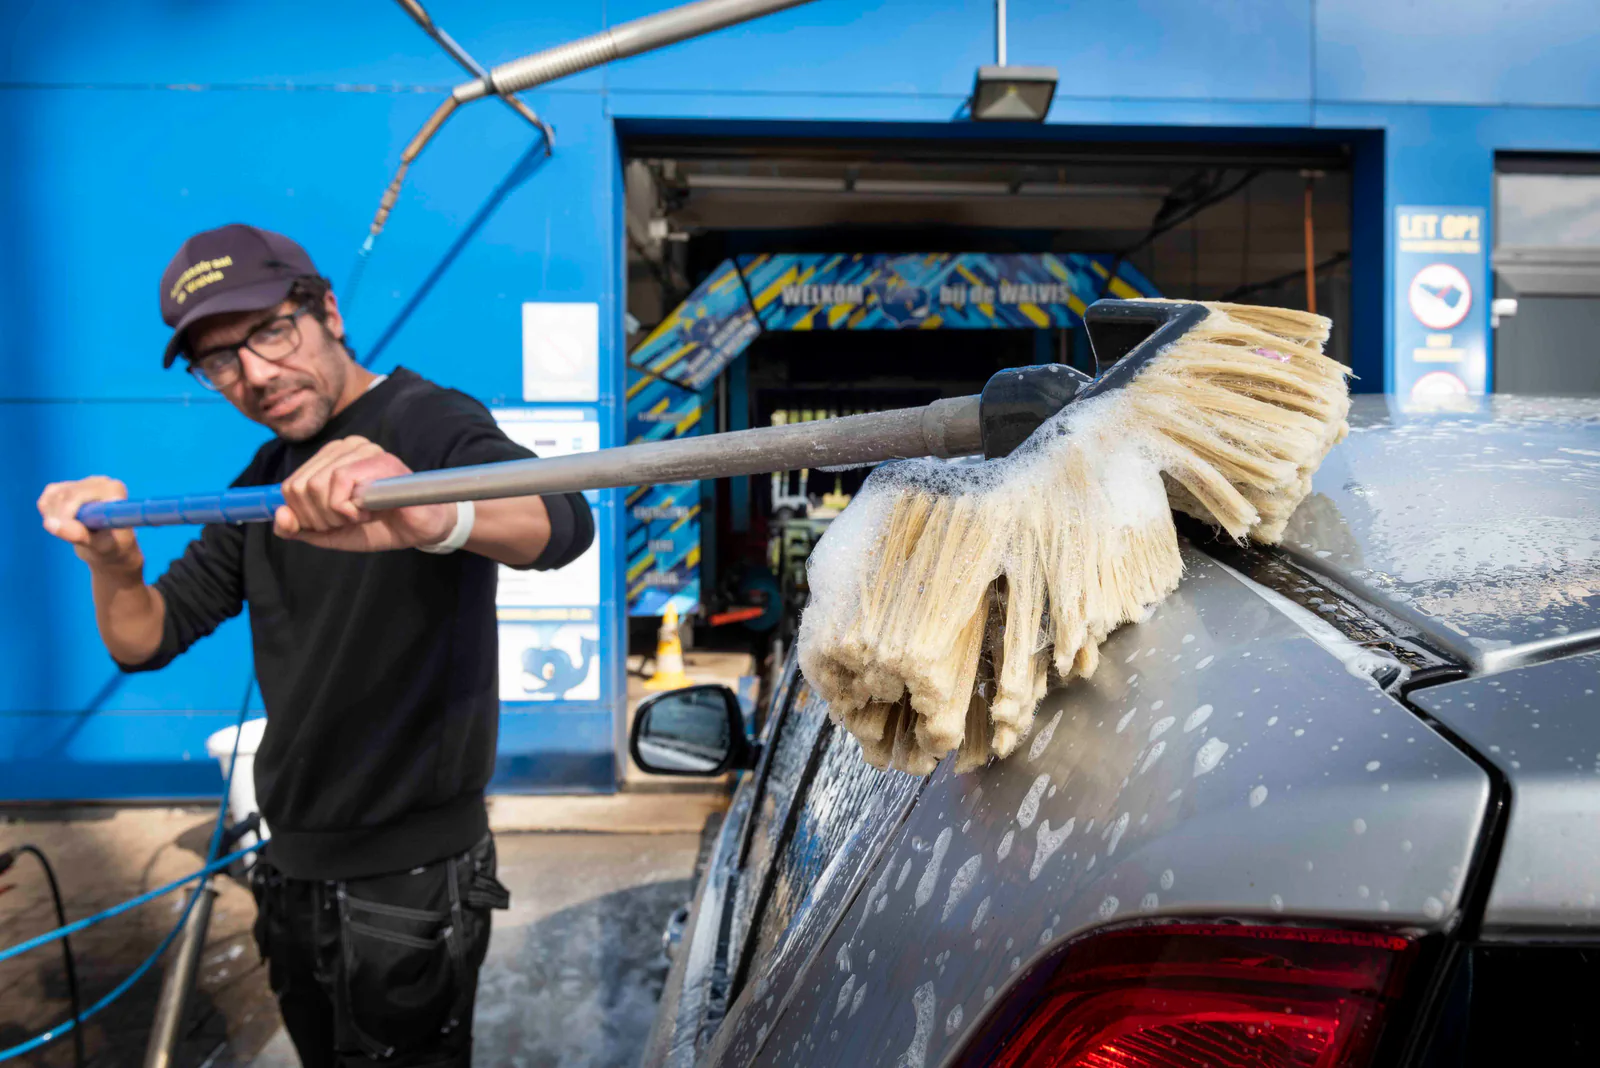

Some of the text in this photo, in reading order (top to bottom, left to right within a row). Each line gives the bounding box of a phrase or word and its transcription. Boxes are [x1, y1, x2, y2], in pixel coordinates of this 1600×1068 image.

[1400, 214, 1480, 239] LET OP!
[782, 284, 864, 305] WELKOM
[939, 283, 1070, 307] bij de WALVIS
